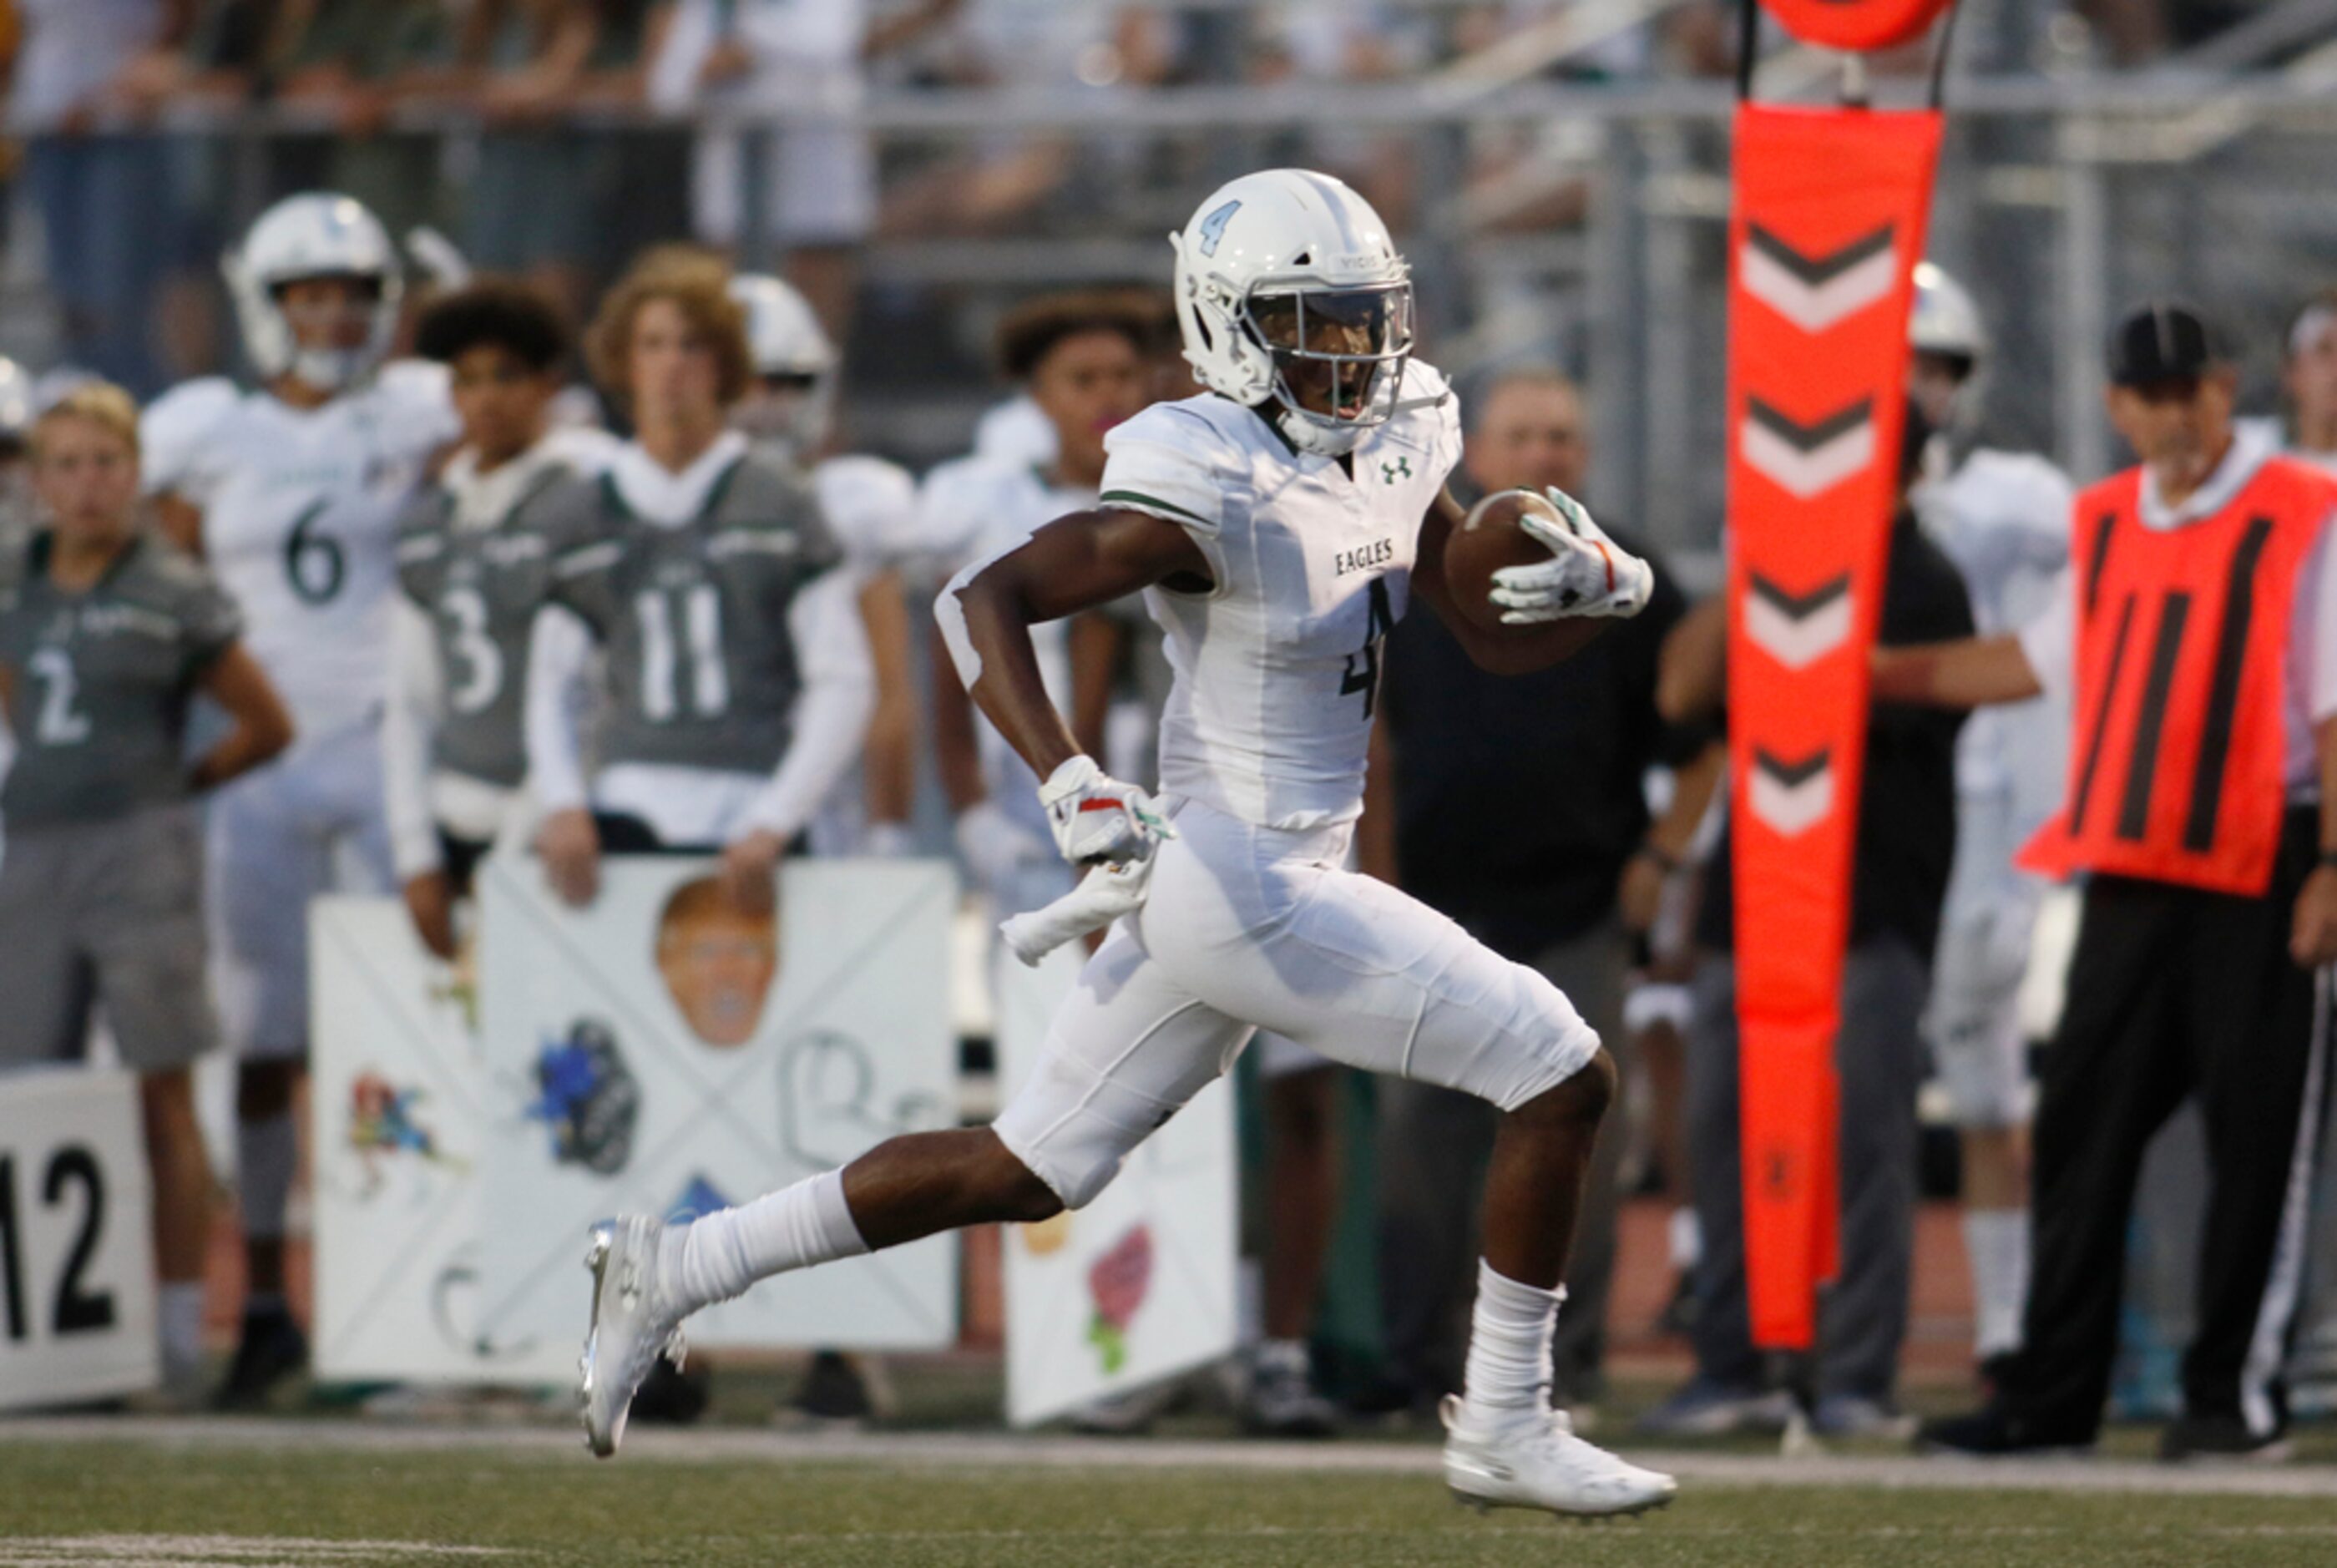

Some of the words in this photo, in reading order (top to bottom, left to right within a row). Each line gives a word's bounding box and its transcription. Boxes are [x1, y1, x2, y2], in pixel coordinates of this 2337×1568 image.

[1200, 199, 1242, 259] 4
[283, 494, 346, 607] 6
[1335, 538, 1394, 575] EAGLES
[29, 648, 91, 742] 2
[439, 587, 503, 712] 3
[635, 586, 728, 720] 11
[1339, 576, 1393, 721] 4
